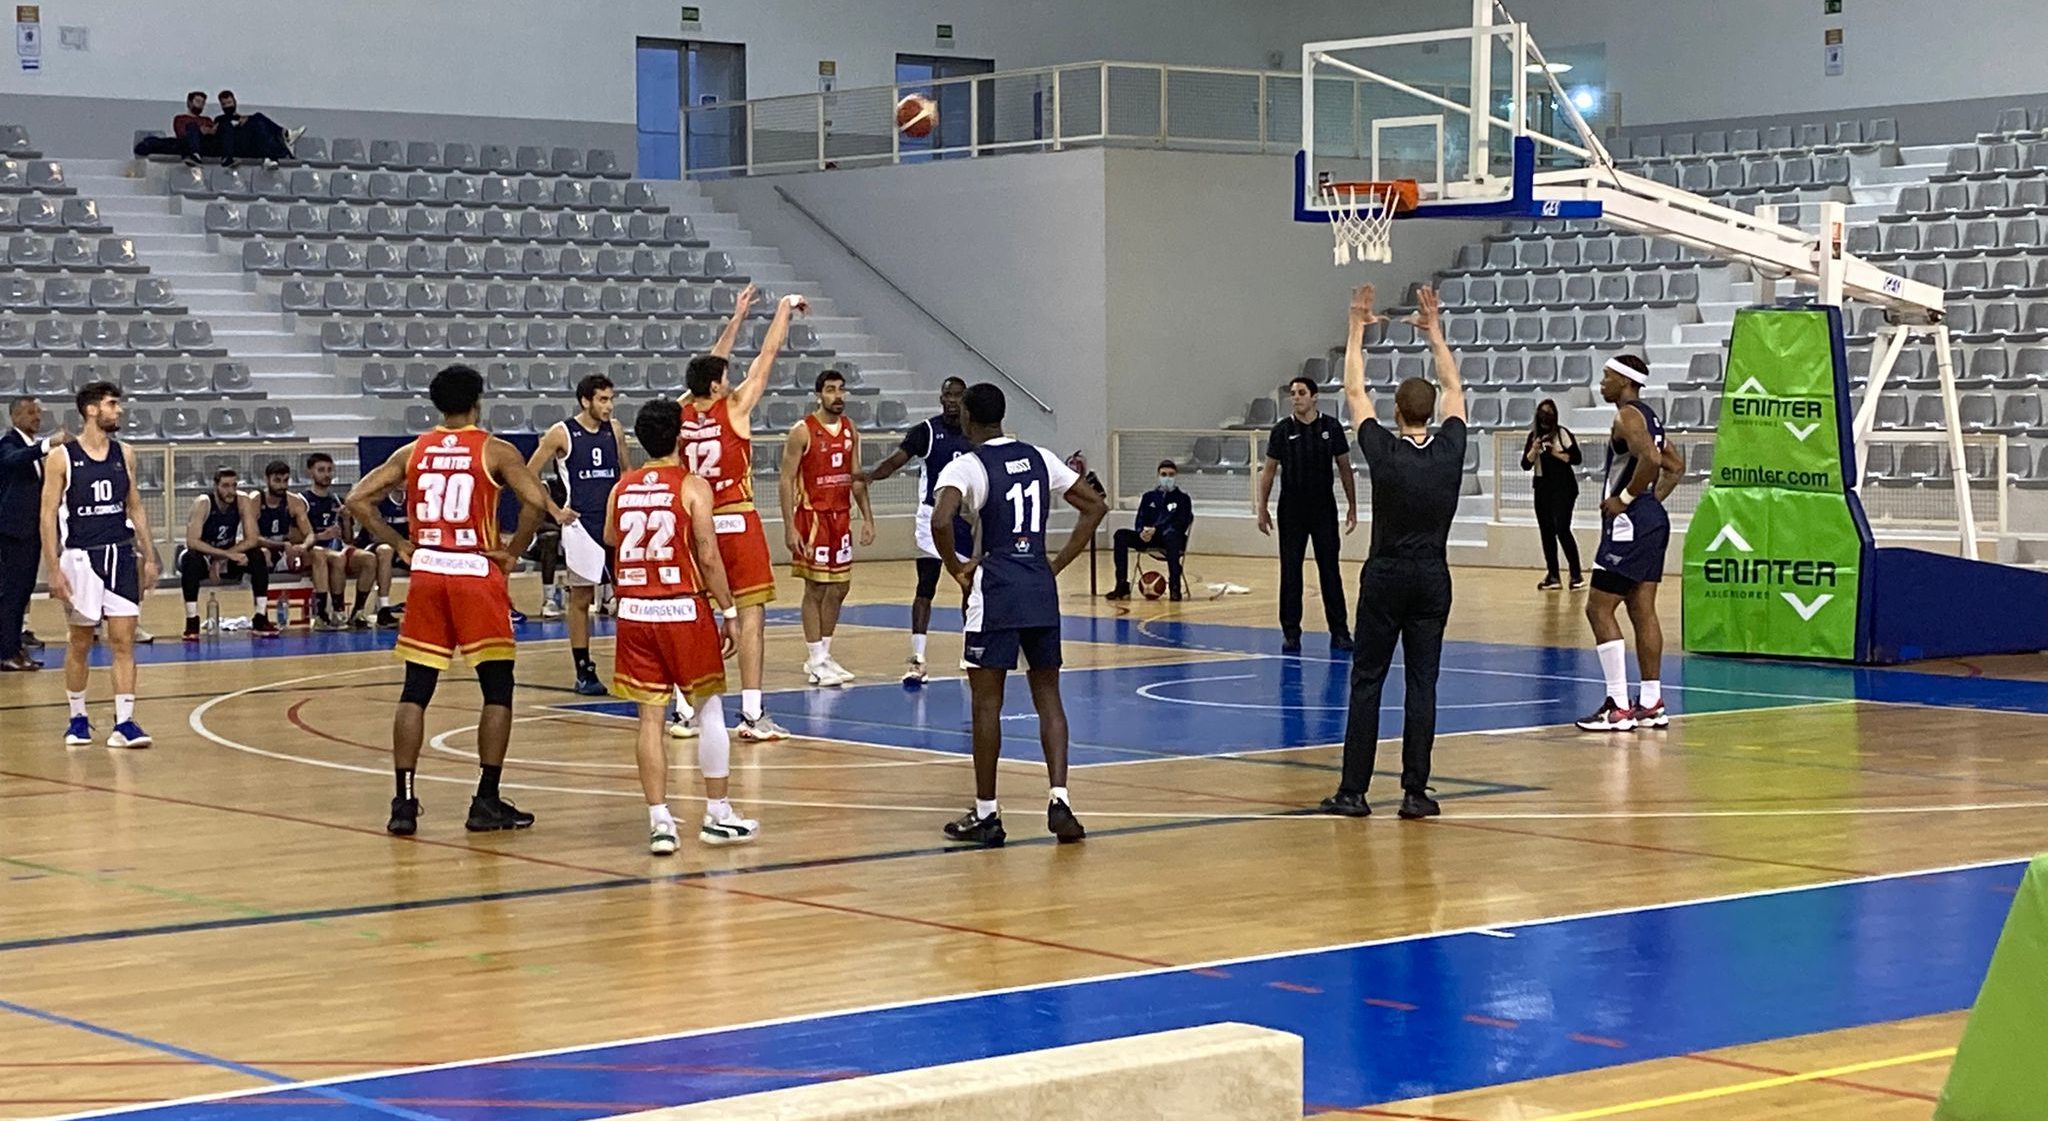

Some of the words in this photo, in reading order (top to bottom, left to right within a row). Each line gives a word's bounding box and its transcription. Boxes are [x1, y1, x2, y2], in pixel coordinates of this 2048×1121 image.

[1732, 398, 1822, 418] ENINTER
[592, 447, 602, 467] 9
[684, 440, 721, 478] 12
[1721, 464, 1829, 487] eninter.com
[90, 480, 112, 502] 10
[416, 472, 475, 523] 30
[1005, 480, 1041, 533] 11
[619, 510, 677, 563] 22
[1704, 558, 1837, 587] ENINTER
